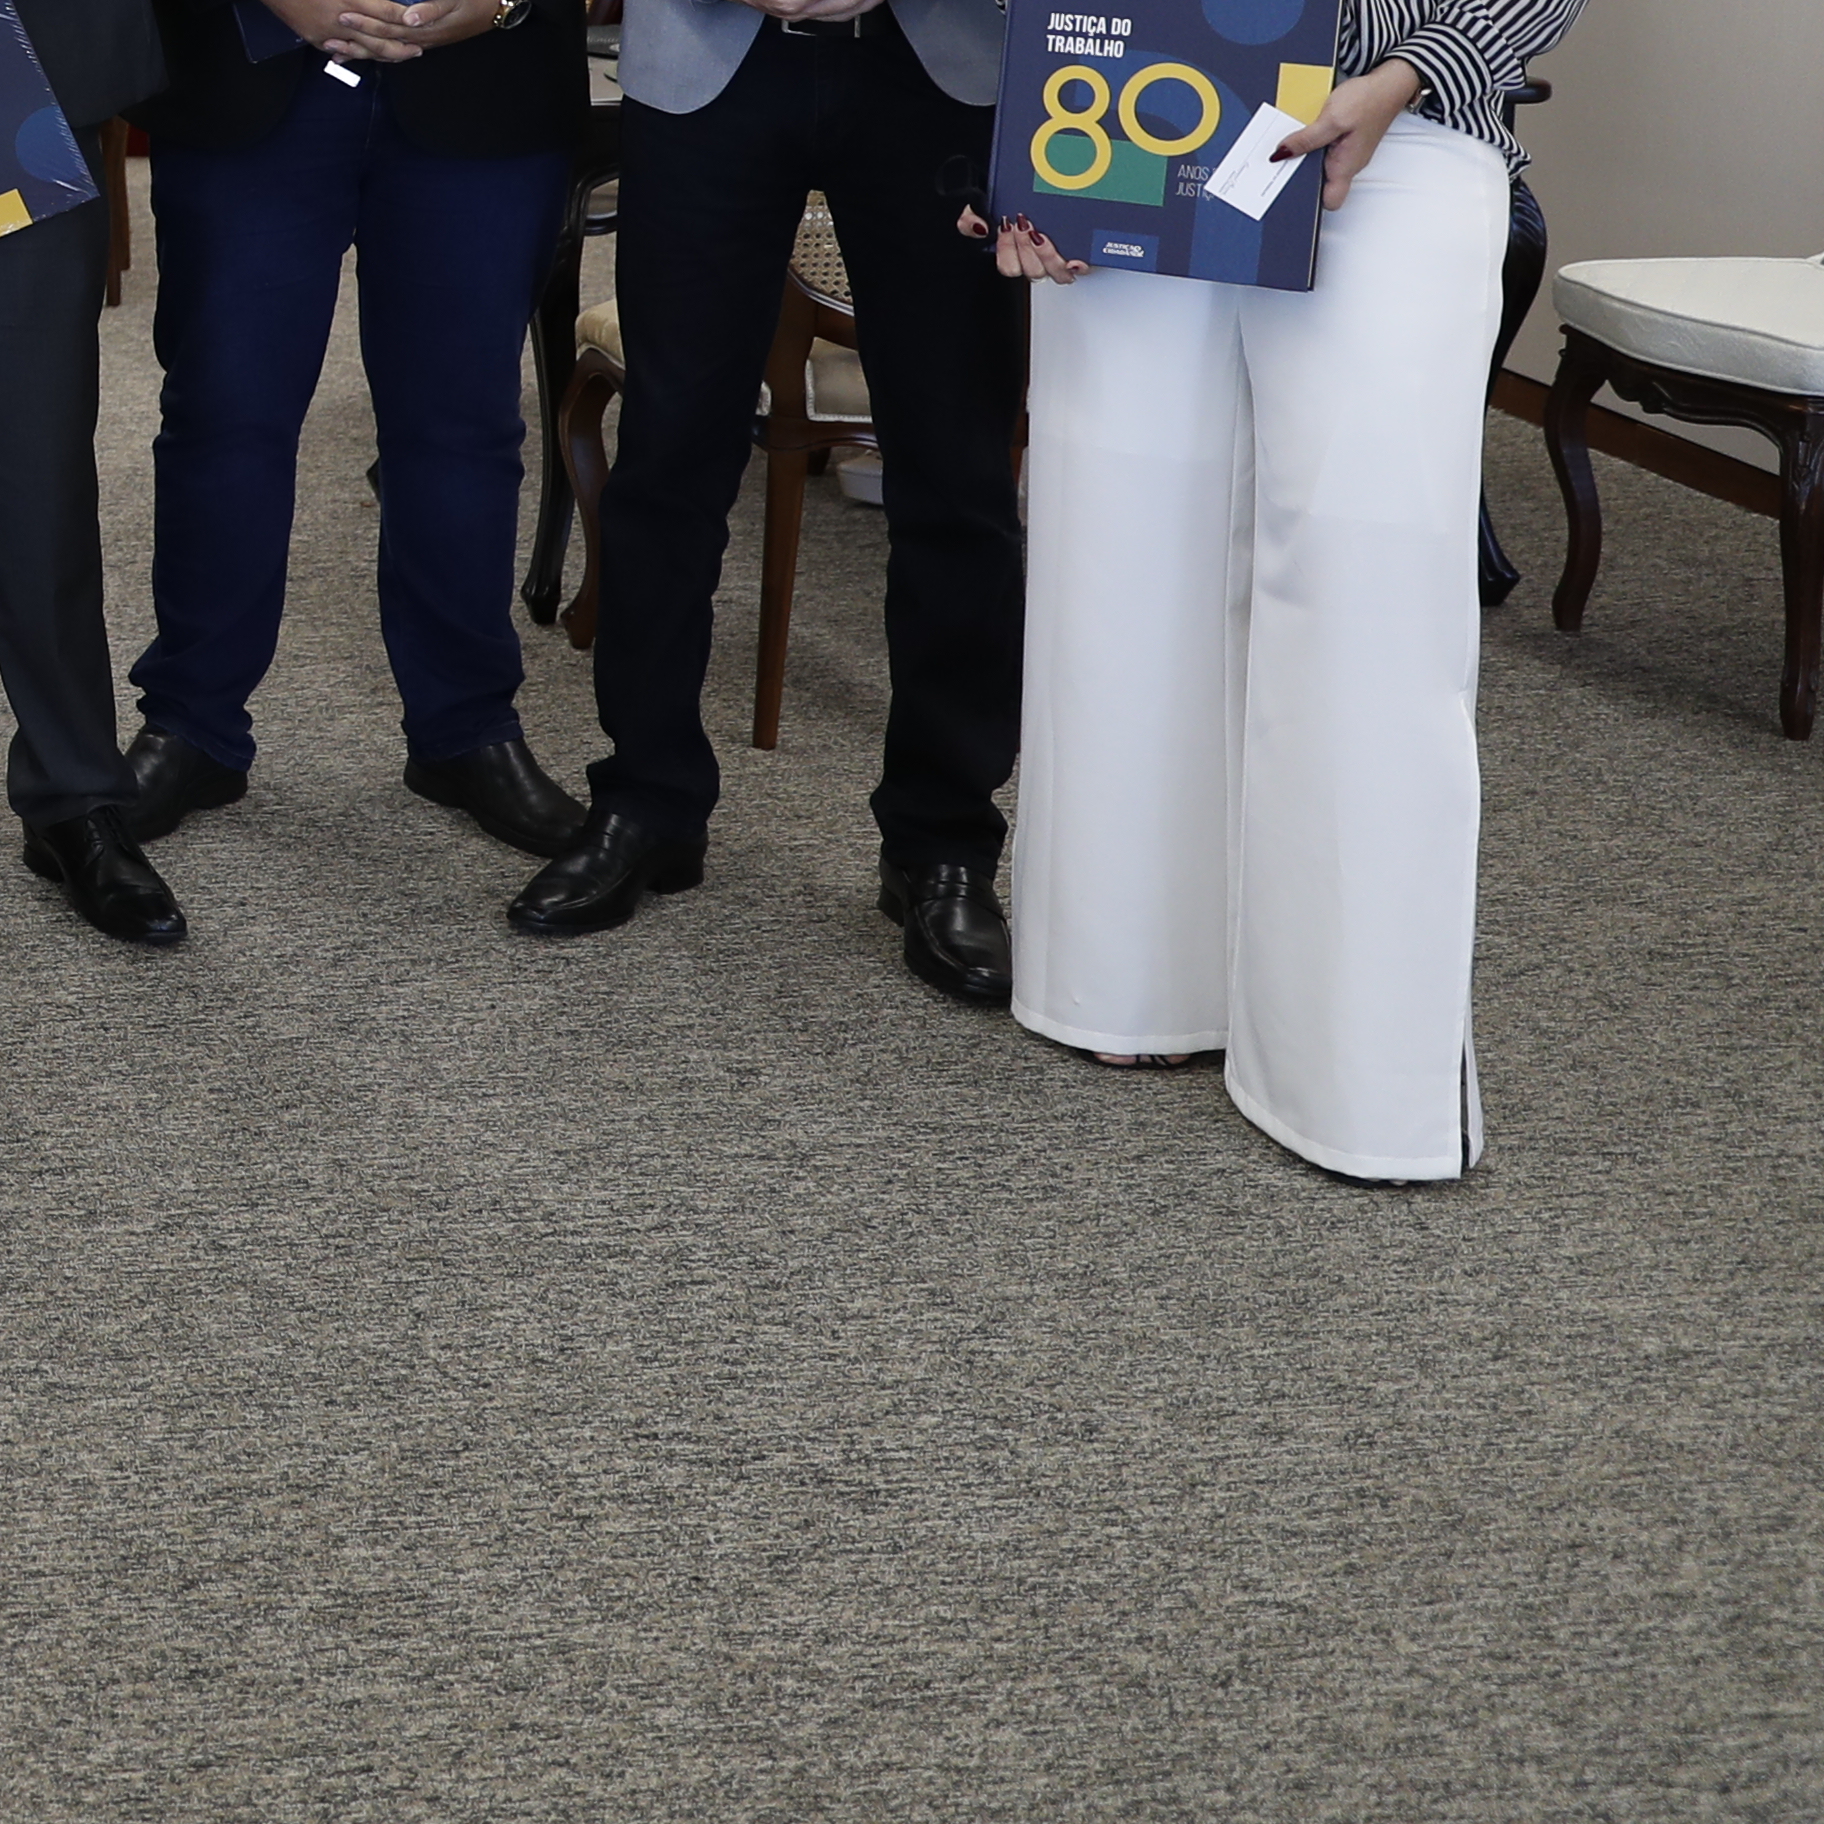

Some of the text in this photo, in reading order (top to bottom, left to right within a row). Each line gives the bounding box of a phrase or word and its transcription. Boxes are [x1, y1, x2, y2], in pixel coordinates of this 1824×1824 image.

[1047, 12, 1132, 36] JUSTIÇA DO
[1046, 34, 1125, 58] TRABALHO
[1030, 62, 1221, 190] 80
[1177, 164, 1211, 181] ANOS
